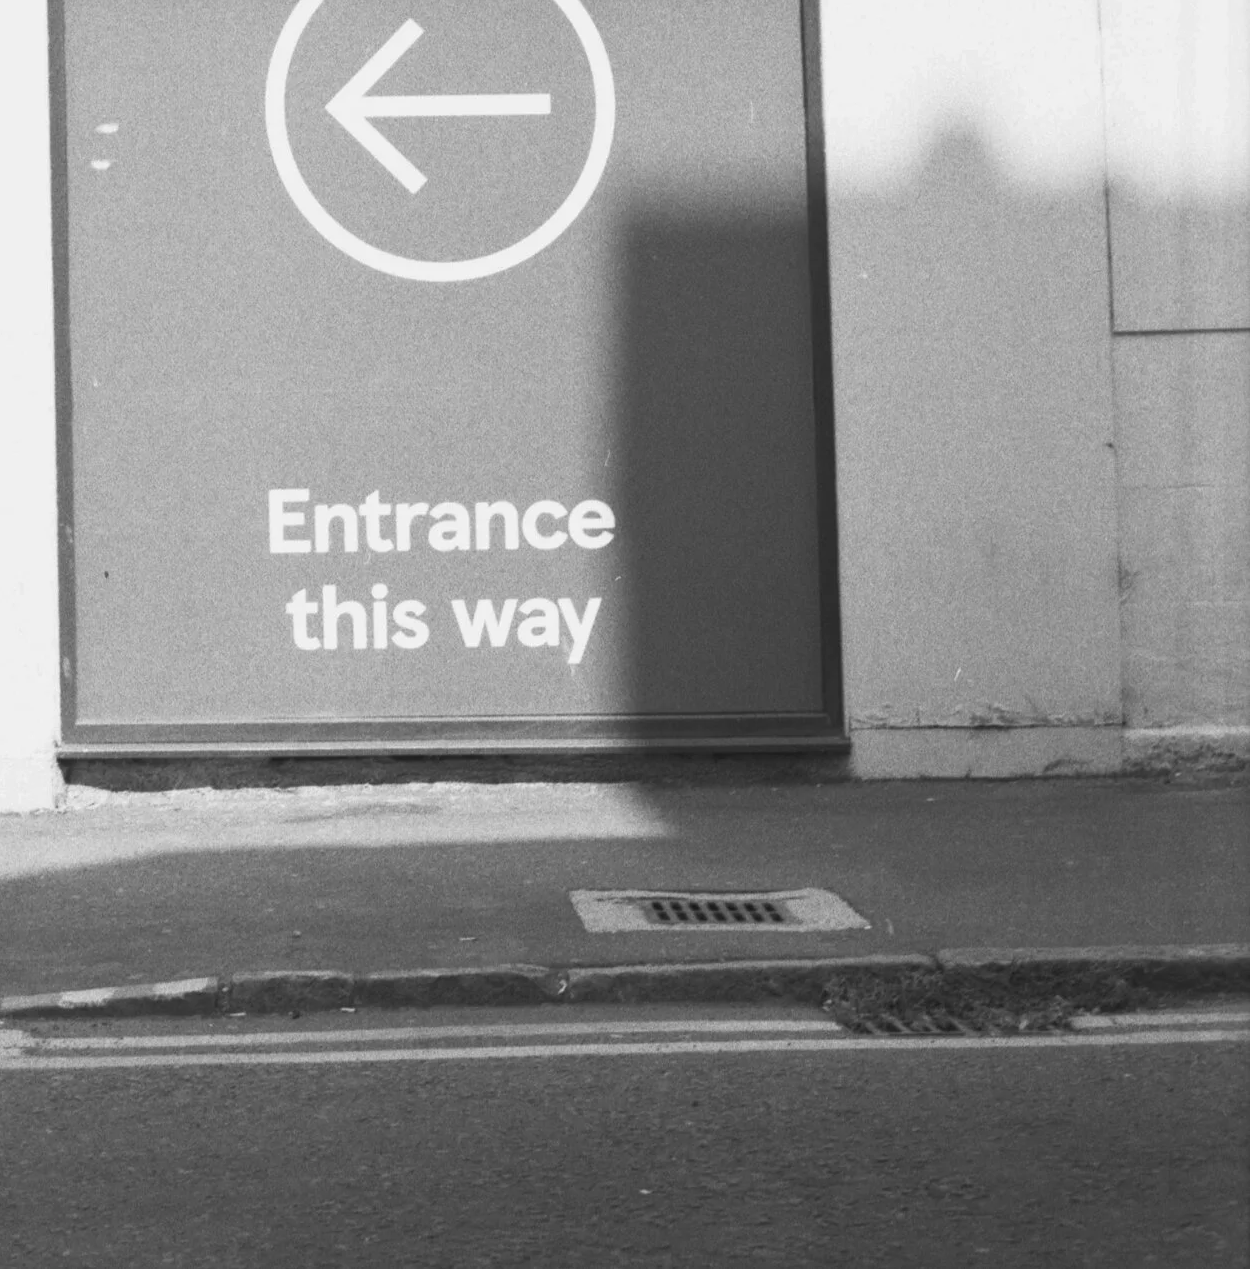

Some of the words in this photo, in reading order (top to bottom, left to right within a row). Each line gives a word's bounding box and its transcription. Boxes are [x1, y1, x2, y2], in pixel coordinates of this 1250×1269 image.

[268, 488, 616, 554] Entrance
[285, 583, 430, 650] this
[451, 597, 602, 665] way
